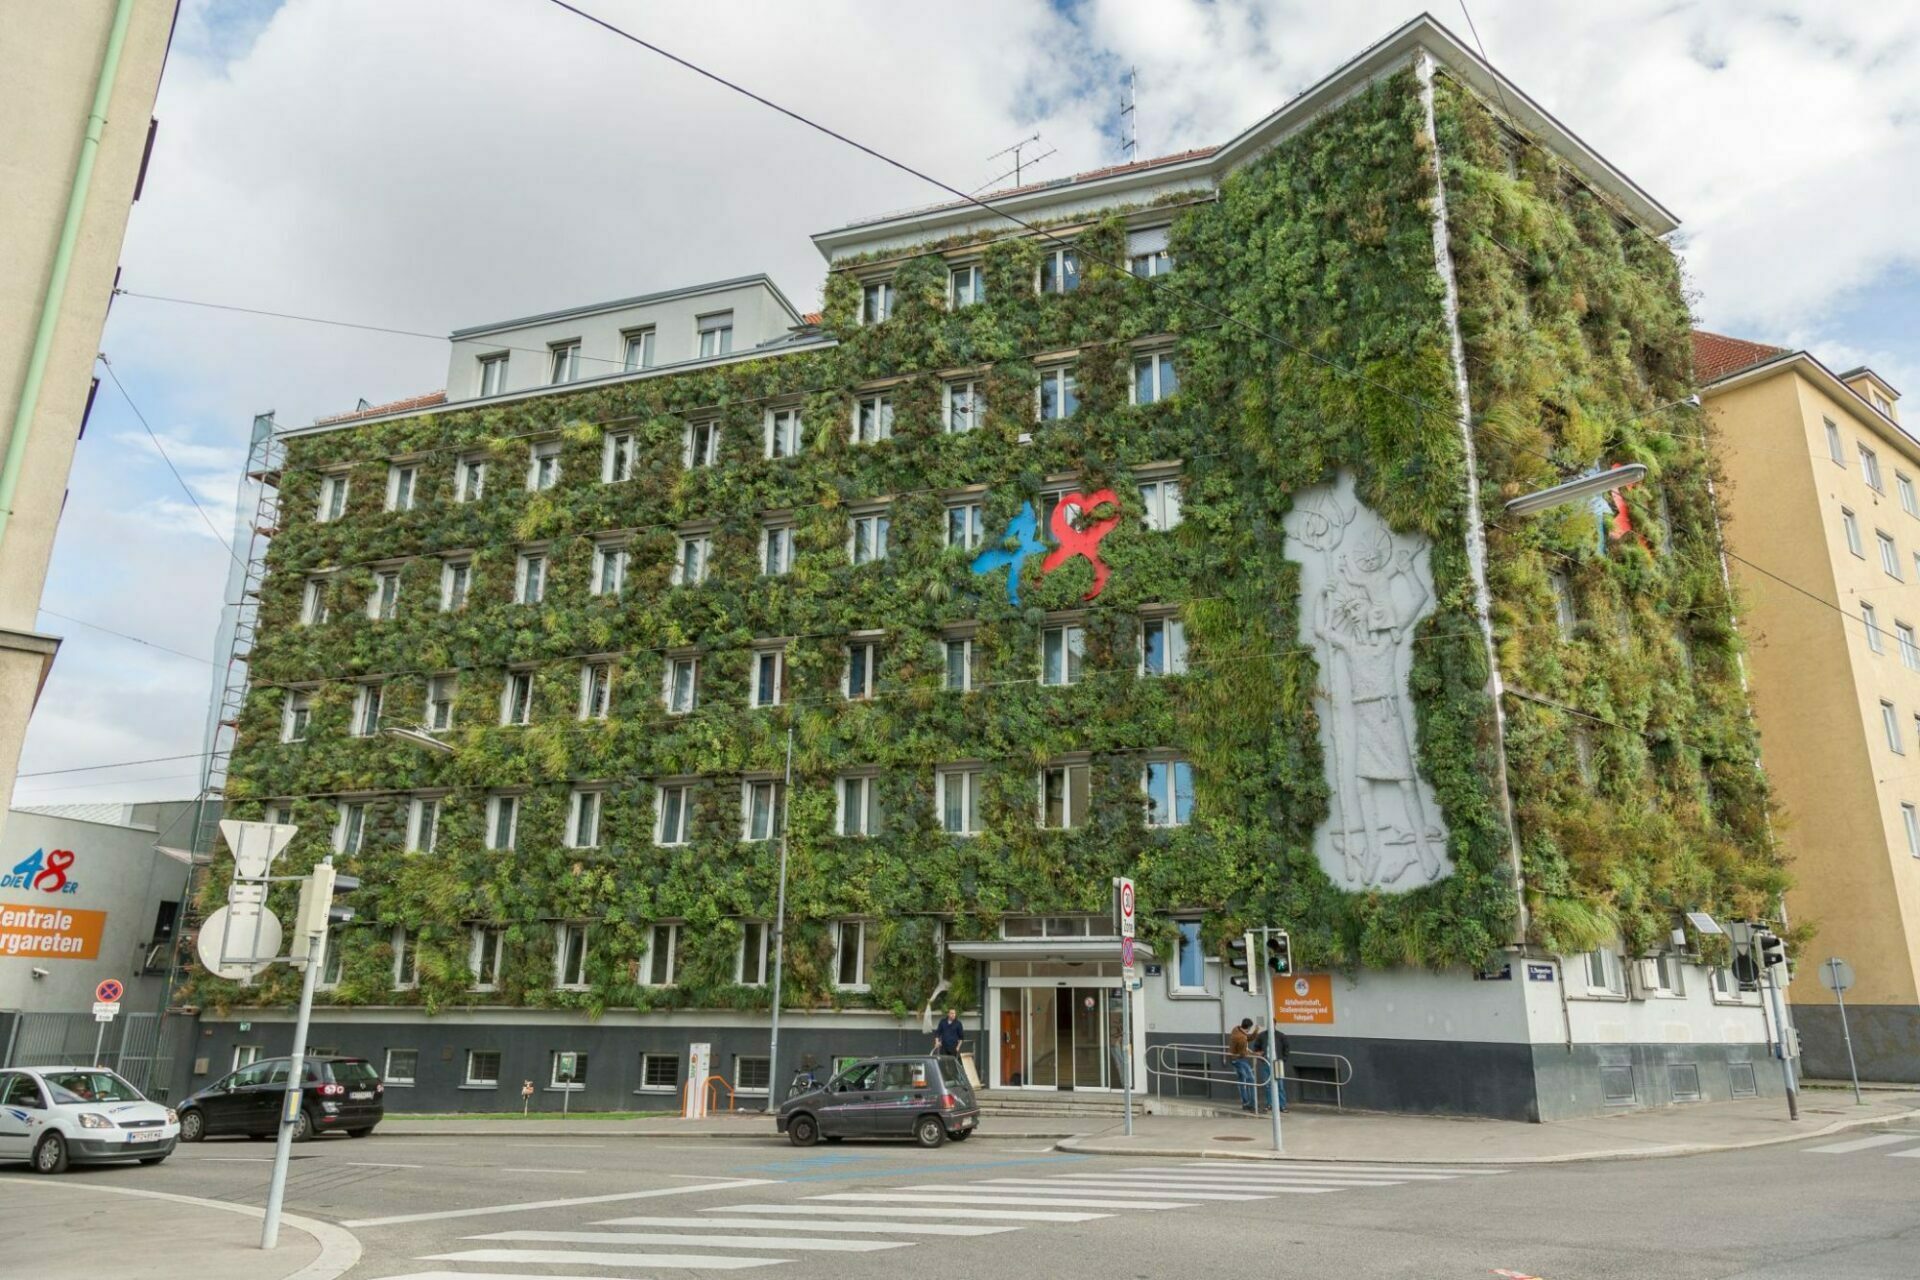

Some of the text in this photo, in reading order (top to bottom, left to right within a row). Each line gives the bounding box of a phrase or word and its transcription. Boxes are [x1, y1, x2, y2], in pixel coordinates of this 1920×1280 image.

[971, 488, 1122, 607] 48
[0, 847, 79, 895] DIE 48 ER
[0, 905, 73, 931] entrale
